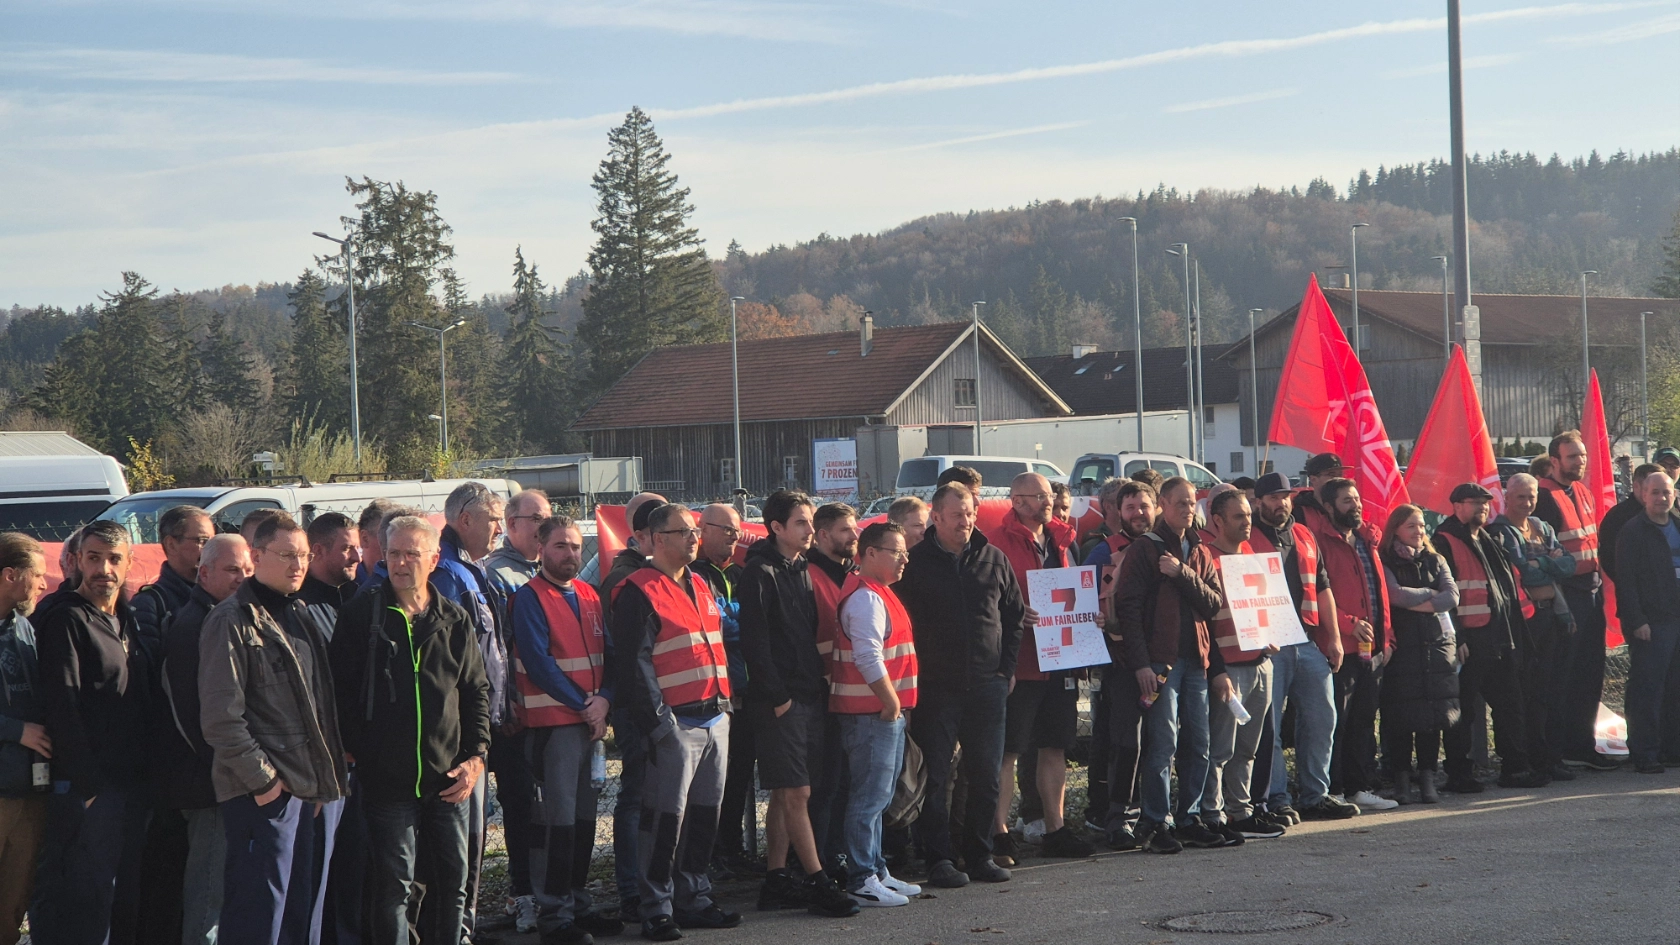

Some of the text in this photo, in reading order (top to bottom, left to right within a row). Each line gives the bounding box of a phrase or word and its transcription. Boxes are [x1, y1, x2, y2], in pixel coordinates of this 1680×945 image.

[821, 469, 826, 478] 7
[1232, 596, 1290, 610] ZUM FAIRLIEBEN
[1243, 573, 1269, 627] 7
[1037, 612, 1097, 628] ZUM FAIRLIEBEN
[1051, 588, 1076, 646] 7
